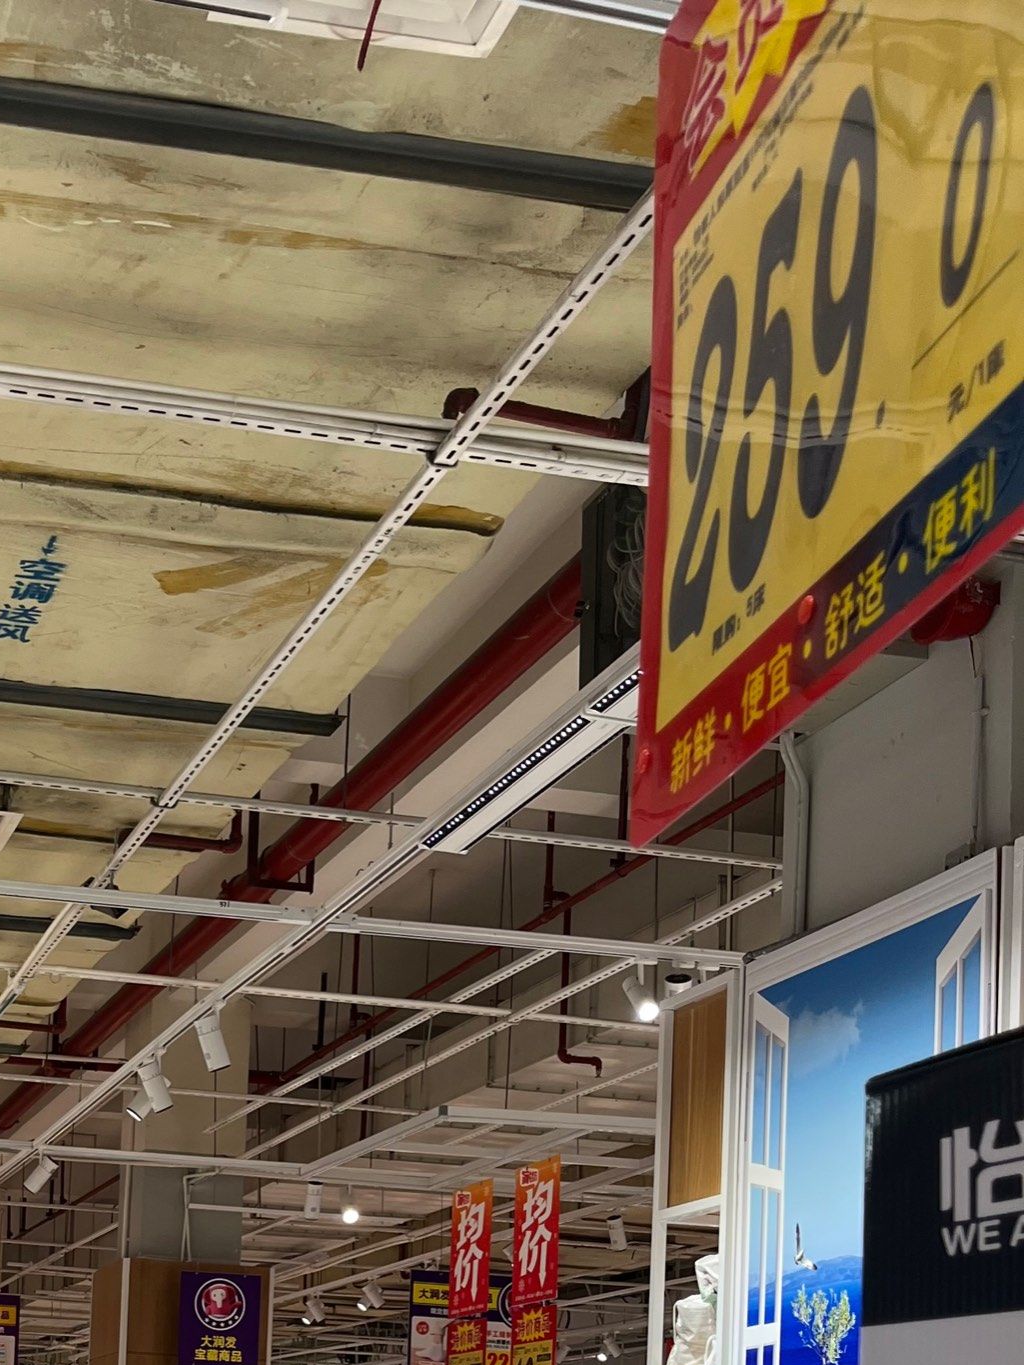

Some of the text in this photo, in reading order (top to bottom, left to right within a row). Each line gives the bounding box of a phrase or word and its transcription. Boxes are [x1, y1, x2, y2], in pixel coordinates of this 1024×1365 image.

[454, 1201, 486, 1303] 均价
[518, 1179, 554, 1289] 均价
[940, 1219, 1002, 1257] WE
[194, 1348, 242, 1362] 宝藏商品
[200, 1335, 237, 1348] 大润发
